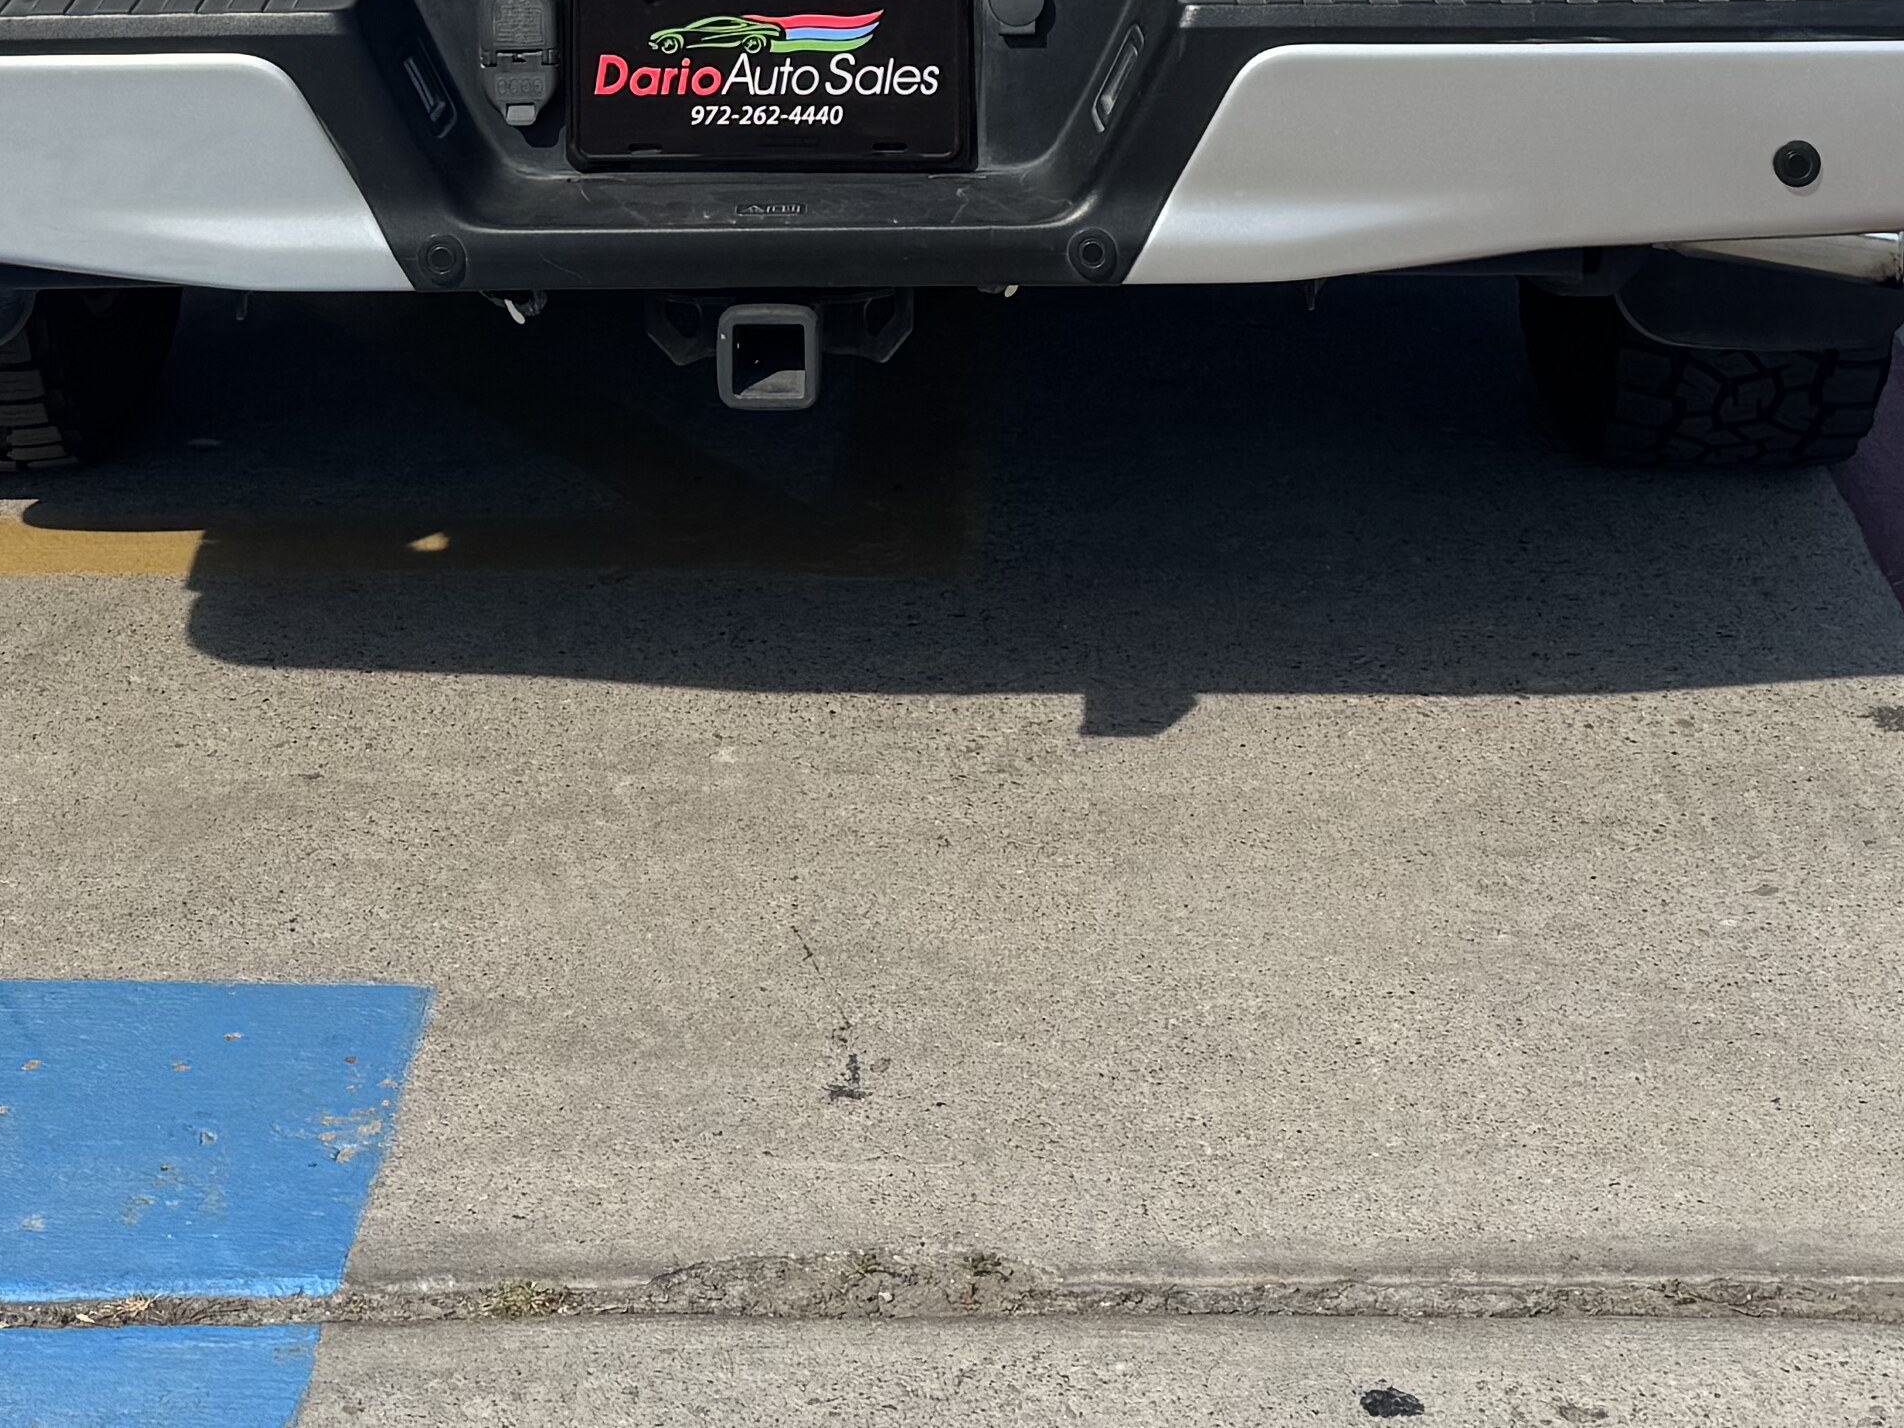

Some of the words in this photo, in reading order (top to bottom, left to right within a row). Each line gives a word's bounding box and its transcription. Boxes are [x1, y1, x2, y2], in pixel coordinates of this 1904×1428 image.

[593, 54, 720, 97] Dario
[721, 52, 819, 96] Auto
[824, 52, 940, 97] Sales
[690, 105, 844, 127] 972-262-4440
